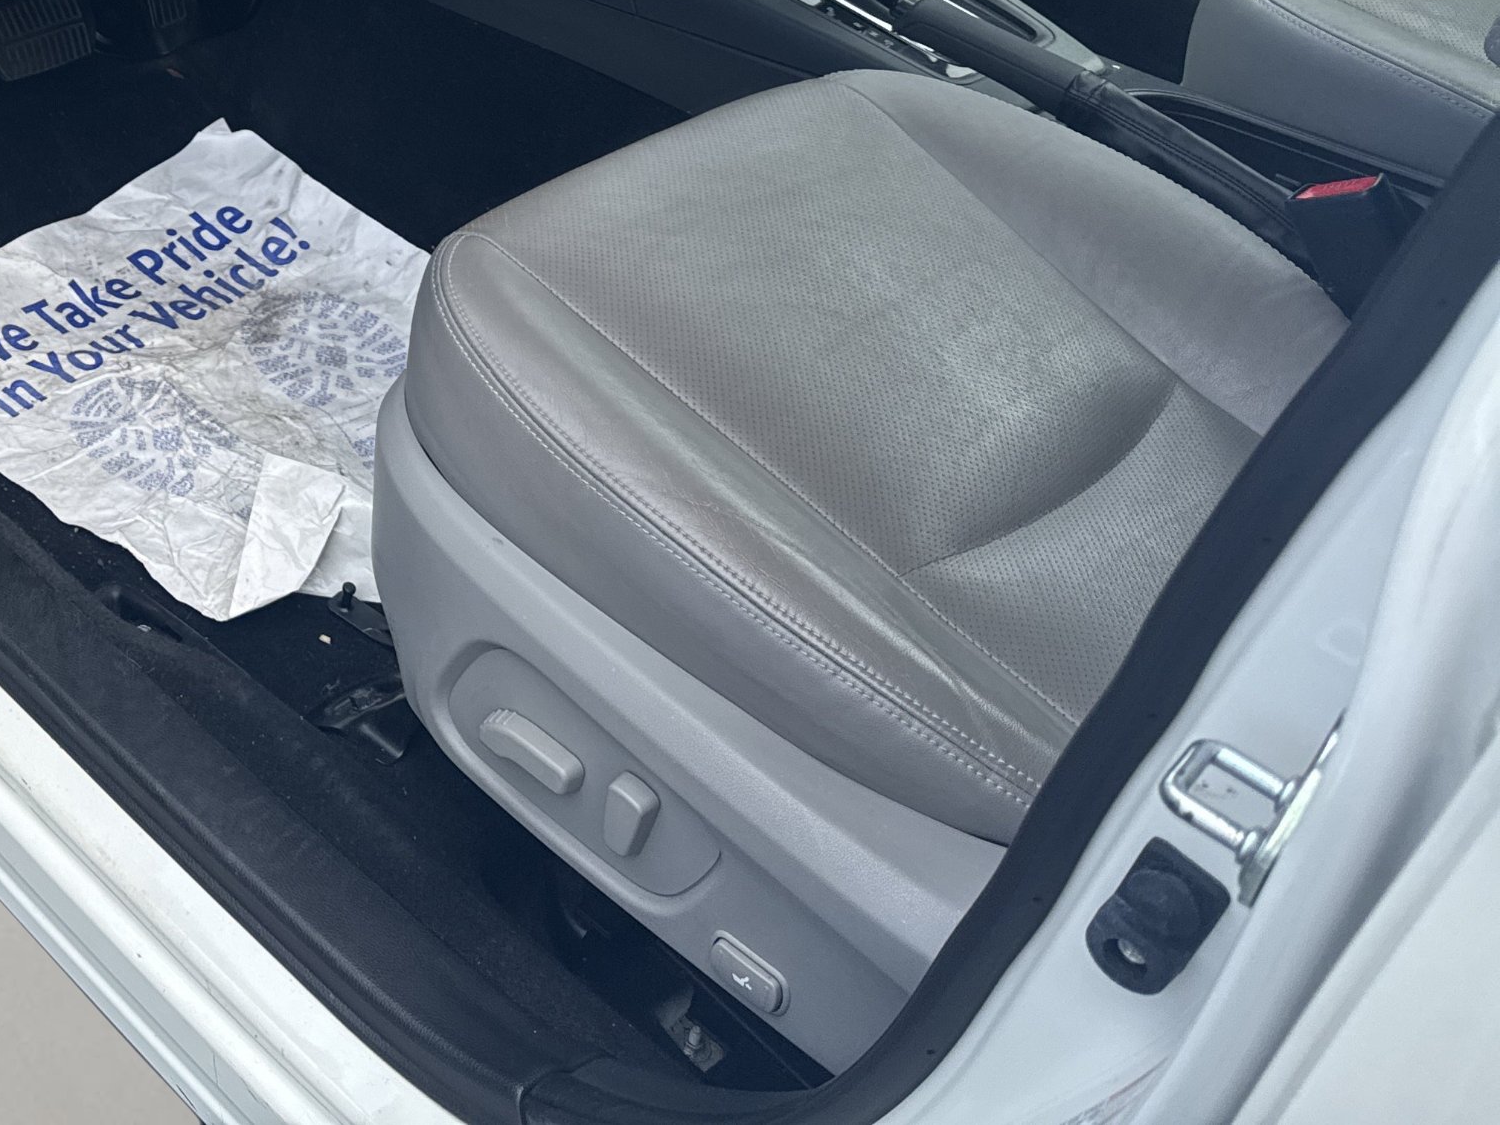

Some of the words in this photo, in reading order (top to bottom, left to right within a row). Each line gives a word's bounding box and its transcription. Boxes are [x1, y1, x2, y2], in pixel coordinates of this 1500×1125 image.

[21, 278, 142, 335] Take
[126, 205, 253, 286] Pride
[26, 324, 146, 384] Your
[128, 216, 311, 330] Vehicle!
